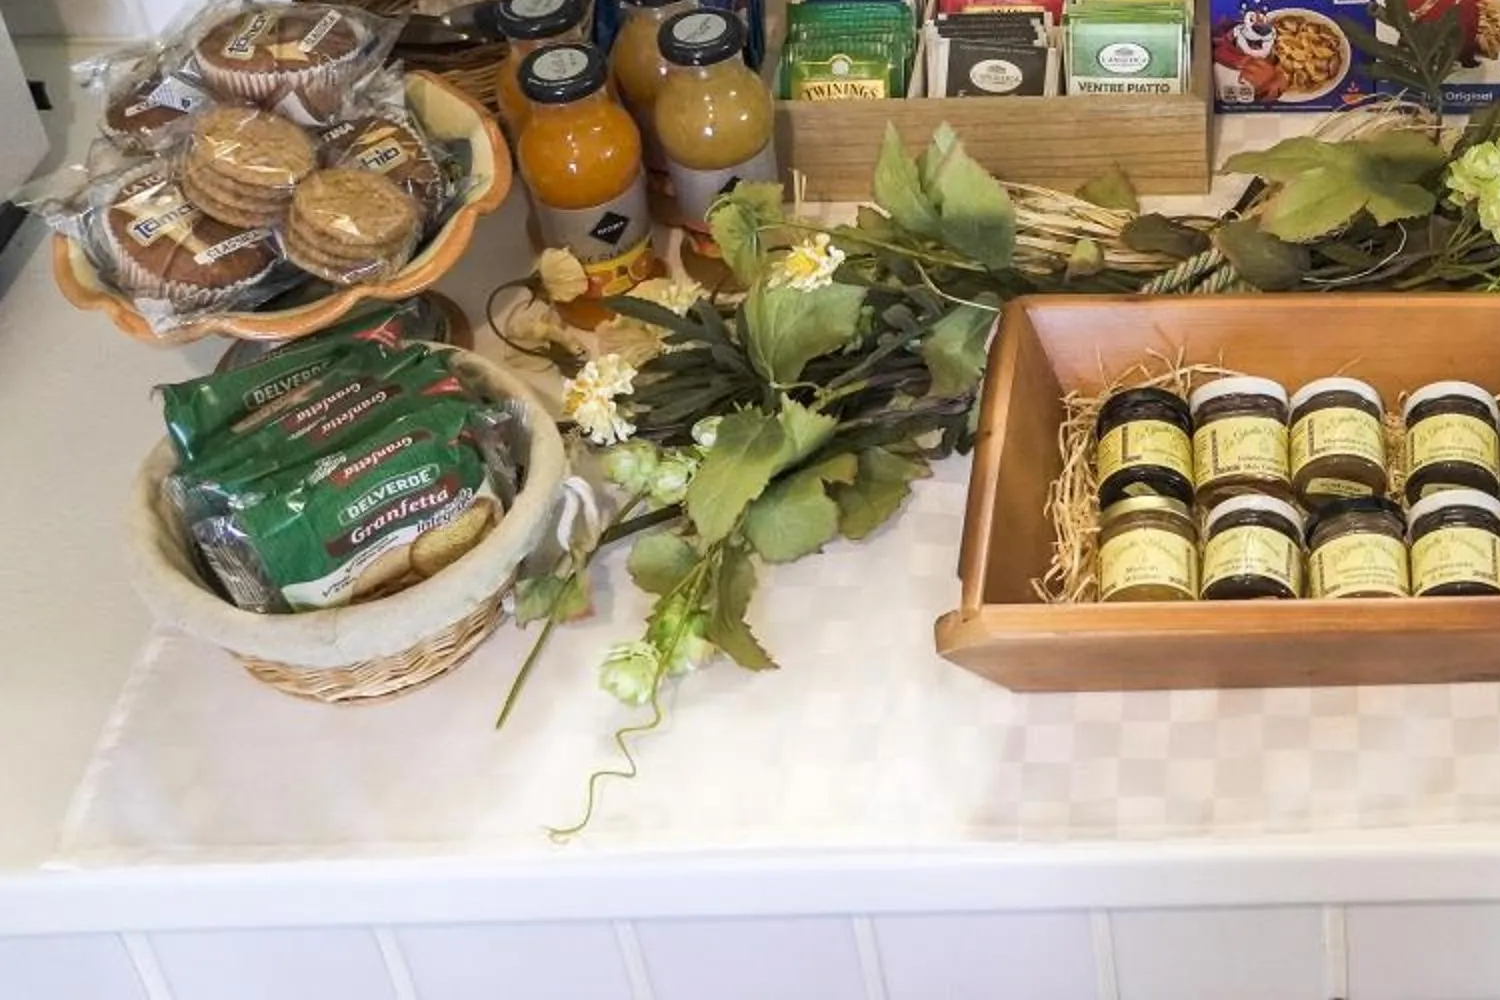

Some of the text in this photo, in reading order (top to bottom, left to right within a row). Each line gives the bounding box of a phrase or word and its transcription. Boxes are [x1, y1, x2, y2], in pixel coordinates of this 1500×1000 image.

[1078, 81, 1171, 95] VENTRE PIATTO
[1445, 91, 1493, 102] Original
[322, 123, 356, 143] TINA
[252, 365, 322, 404] DELVER
[321, 391, 387, 435] Granfetta
[343, 436, 413, 478] Granfetta
[349, 469, 432, 520] DELVERDE
[351, 484, 449, 544] Granfetta
